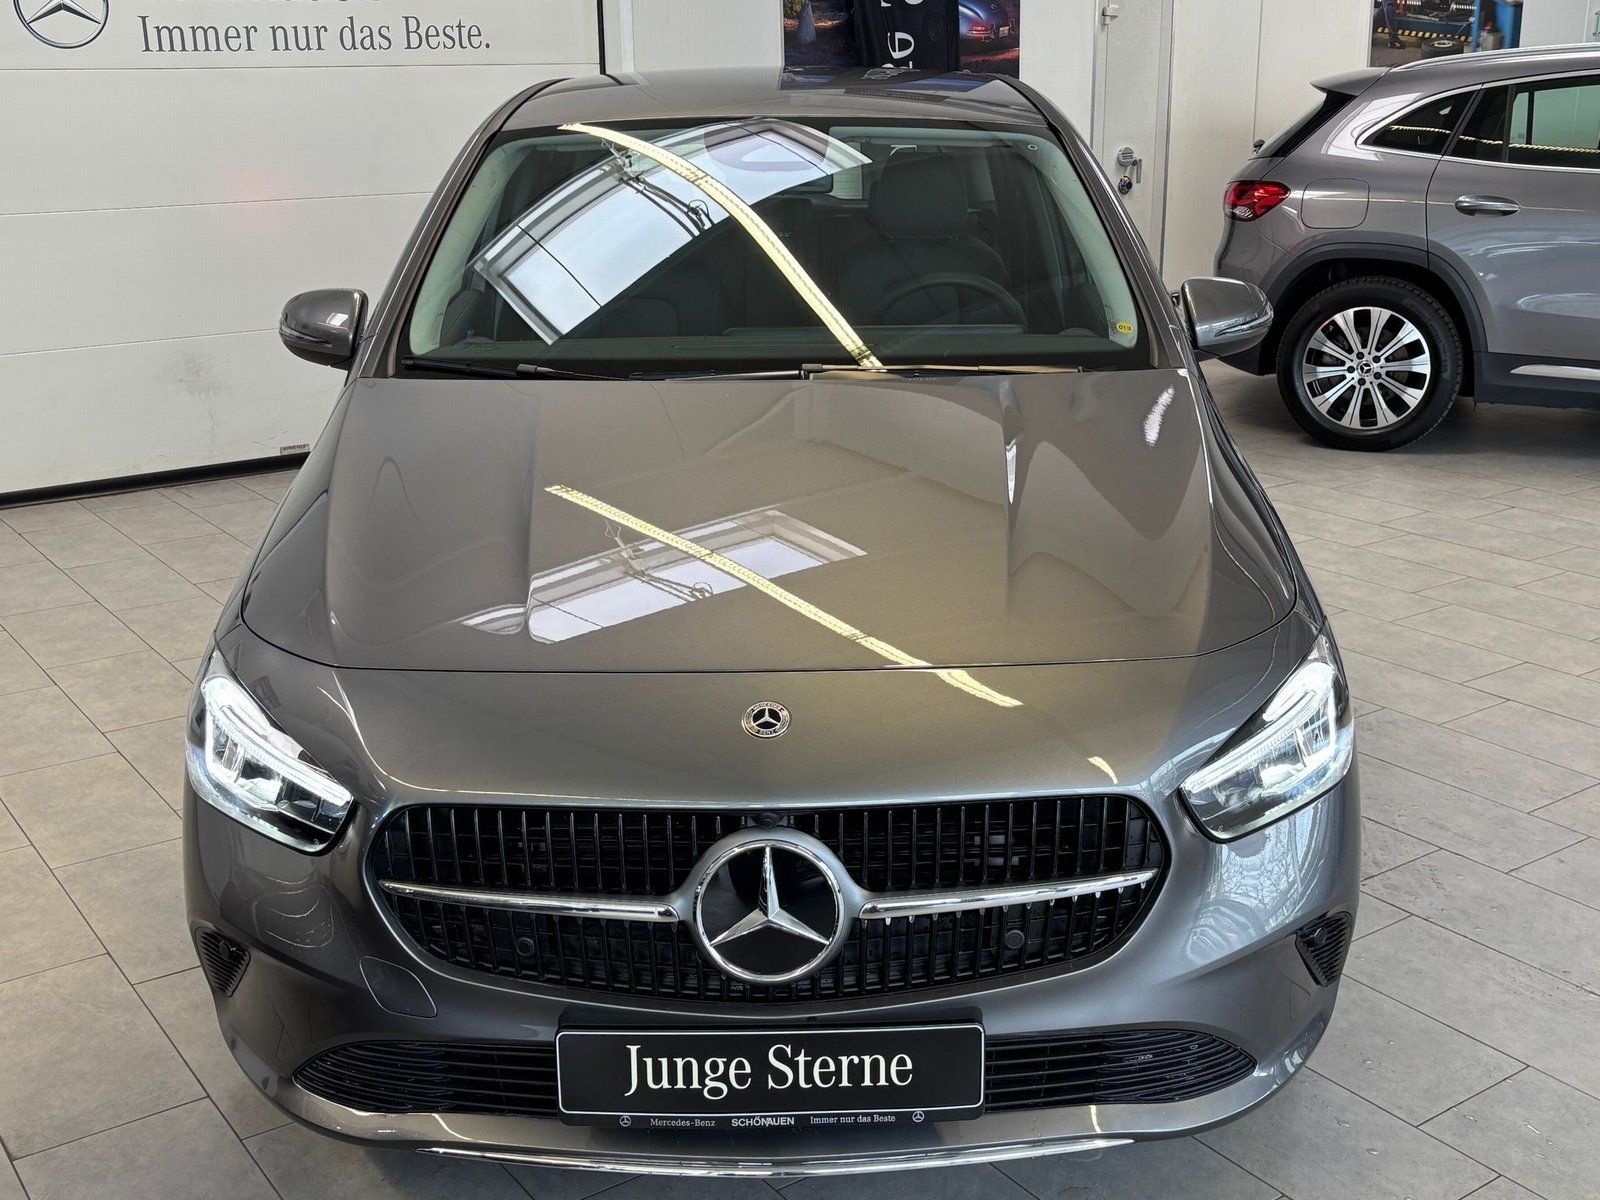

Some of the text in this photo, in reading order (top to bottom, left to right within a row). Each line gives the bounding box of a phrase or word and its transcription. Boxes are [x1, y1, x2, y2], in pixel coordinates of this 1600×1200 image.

[137, 15, 491, 52] Immer nur das Beste.
[624, 1044, 913, 1100] Junge Sterne
[650, 1118, 716, 1127] Mercedes-Benz
[810, 1114, 896, 1124] Immer nur das Beste
